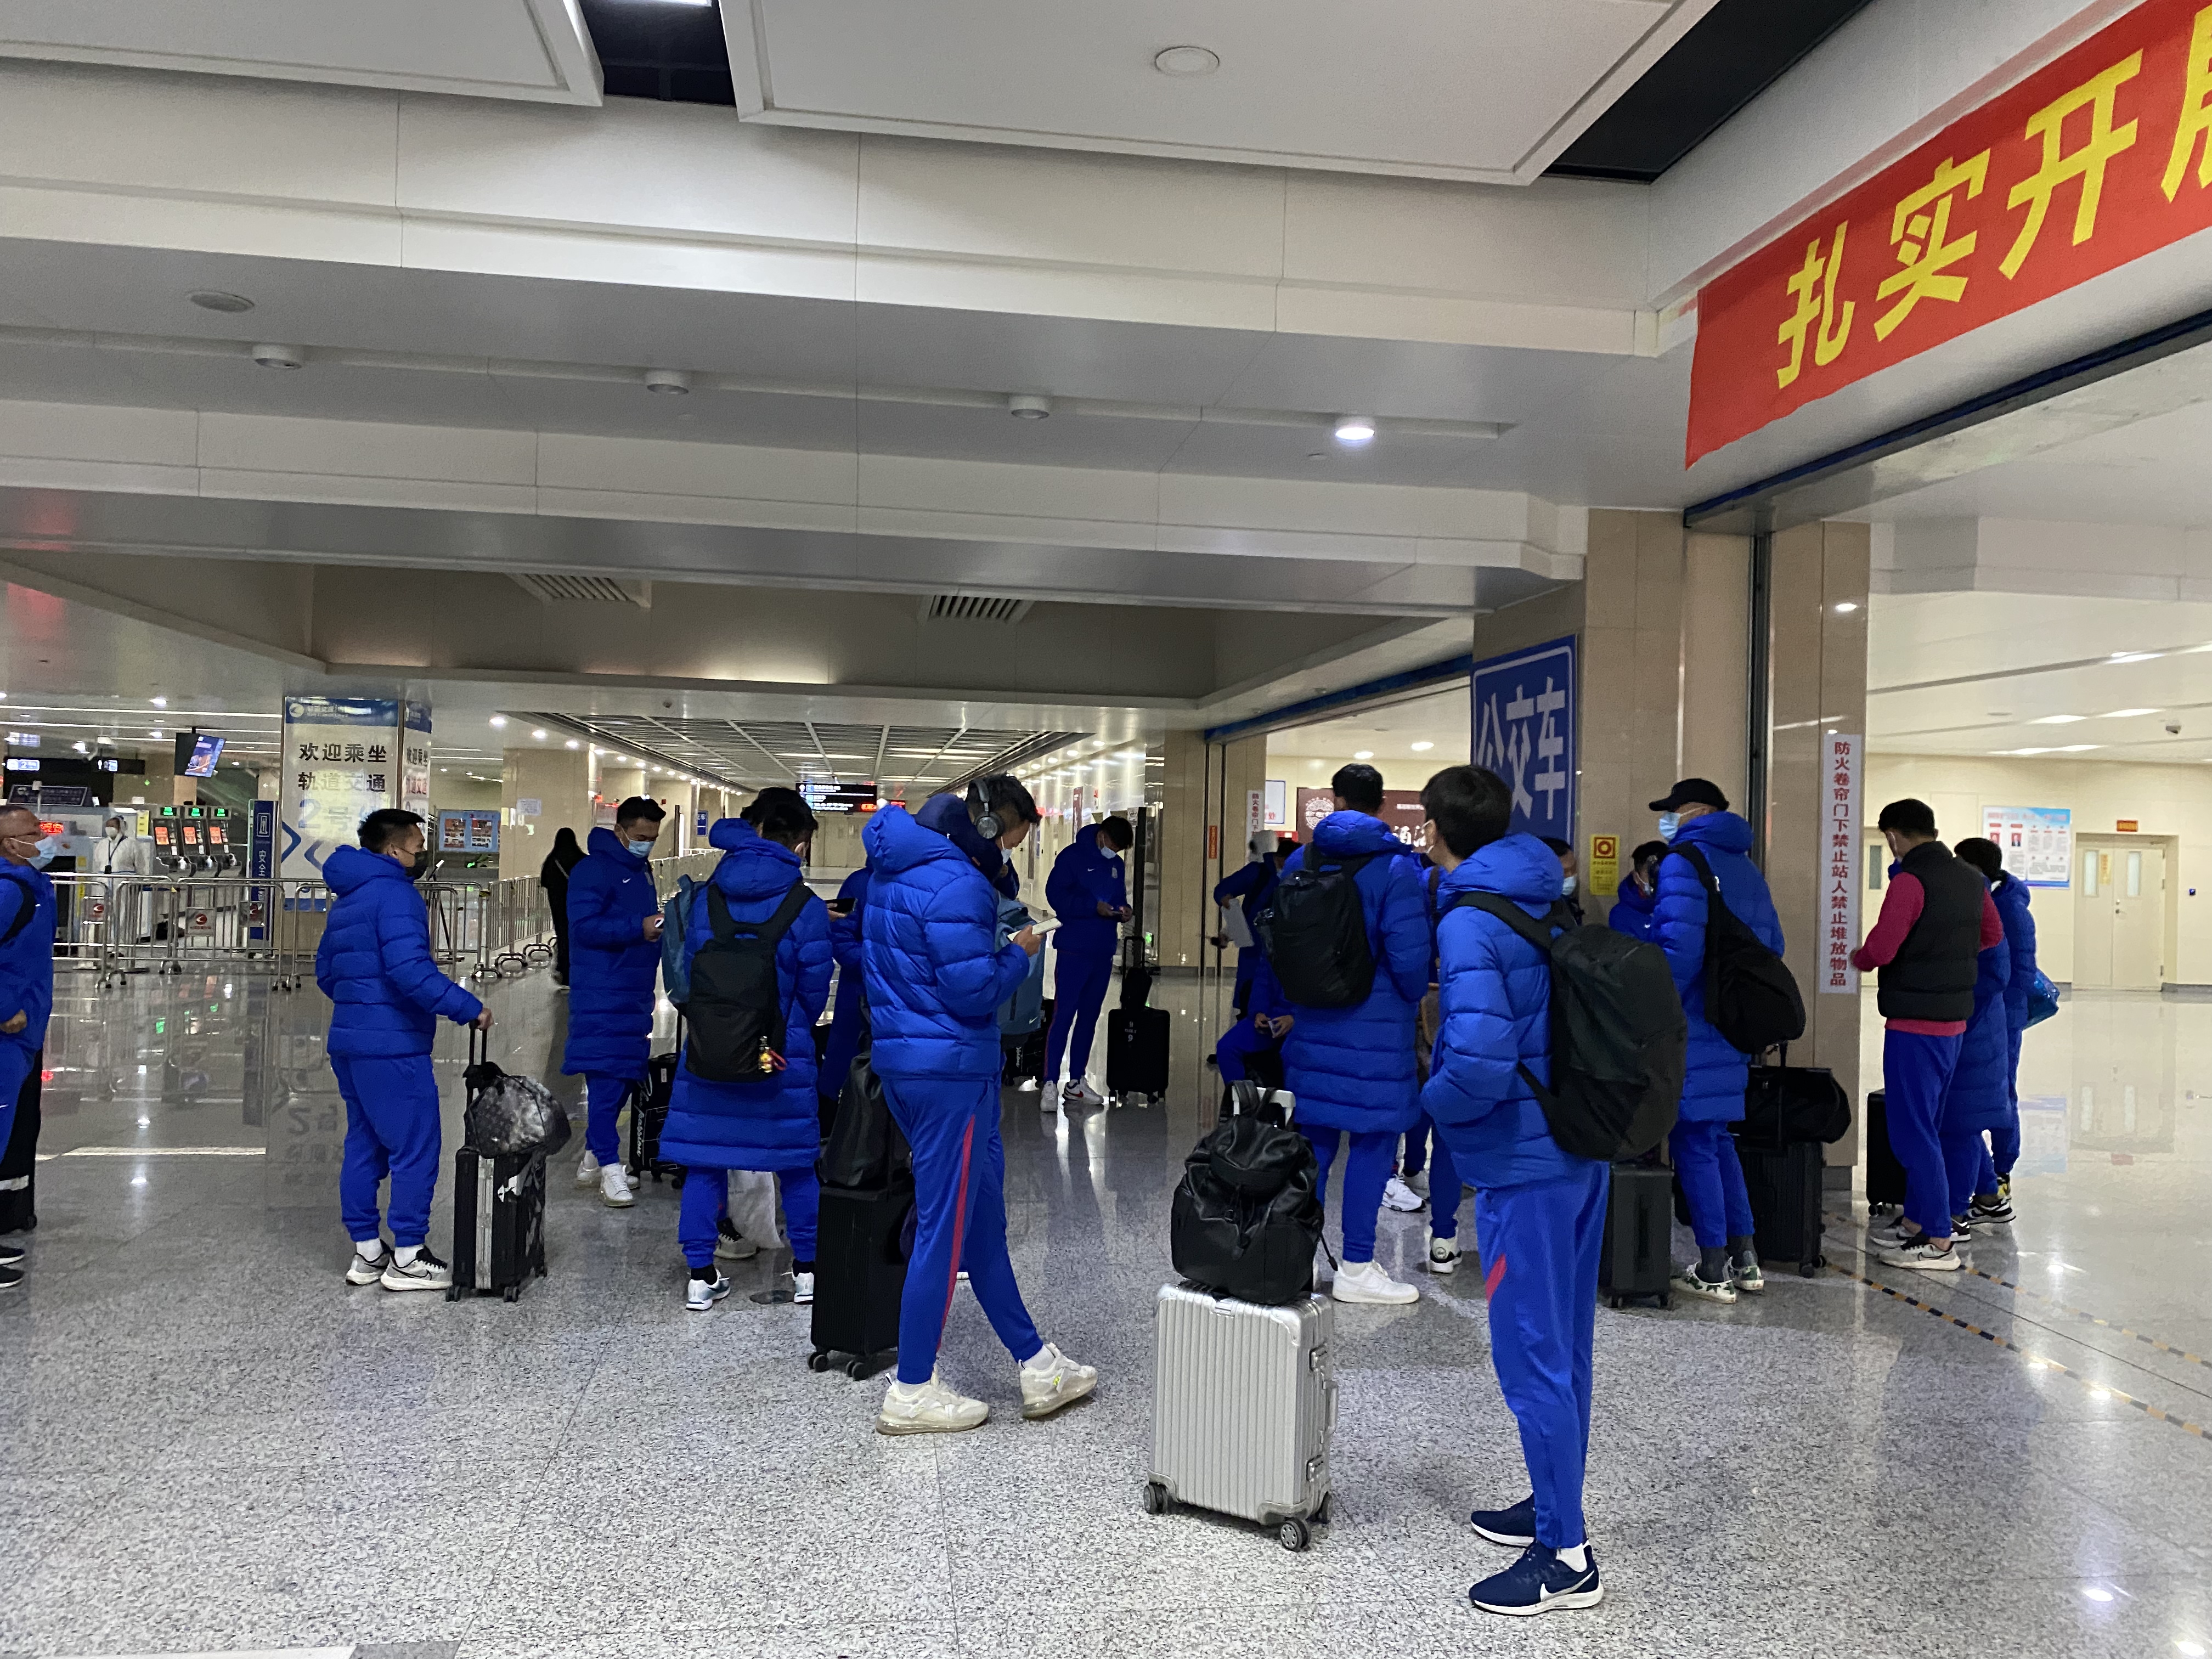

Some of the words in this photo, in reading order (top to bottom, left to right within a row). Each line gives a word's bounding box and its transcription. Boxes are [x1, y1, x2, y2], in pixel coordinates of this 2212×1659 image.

[298, 742, 387, 763] 欢迎乘坐
[298, 771, 386, 792] 轨道交通
[1477, 676, 1566, 820] 公交车
[1830, 741, 1851, 986] 防火卷帘门下禁止站人禁止堆放物品
